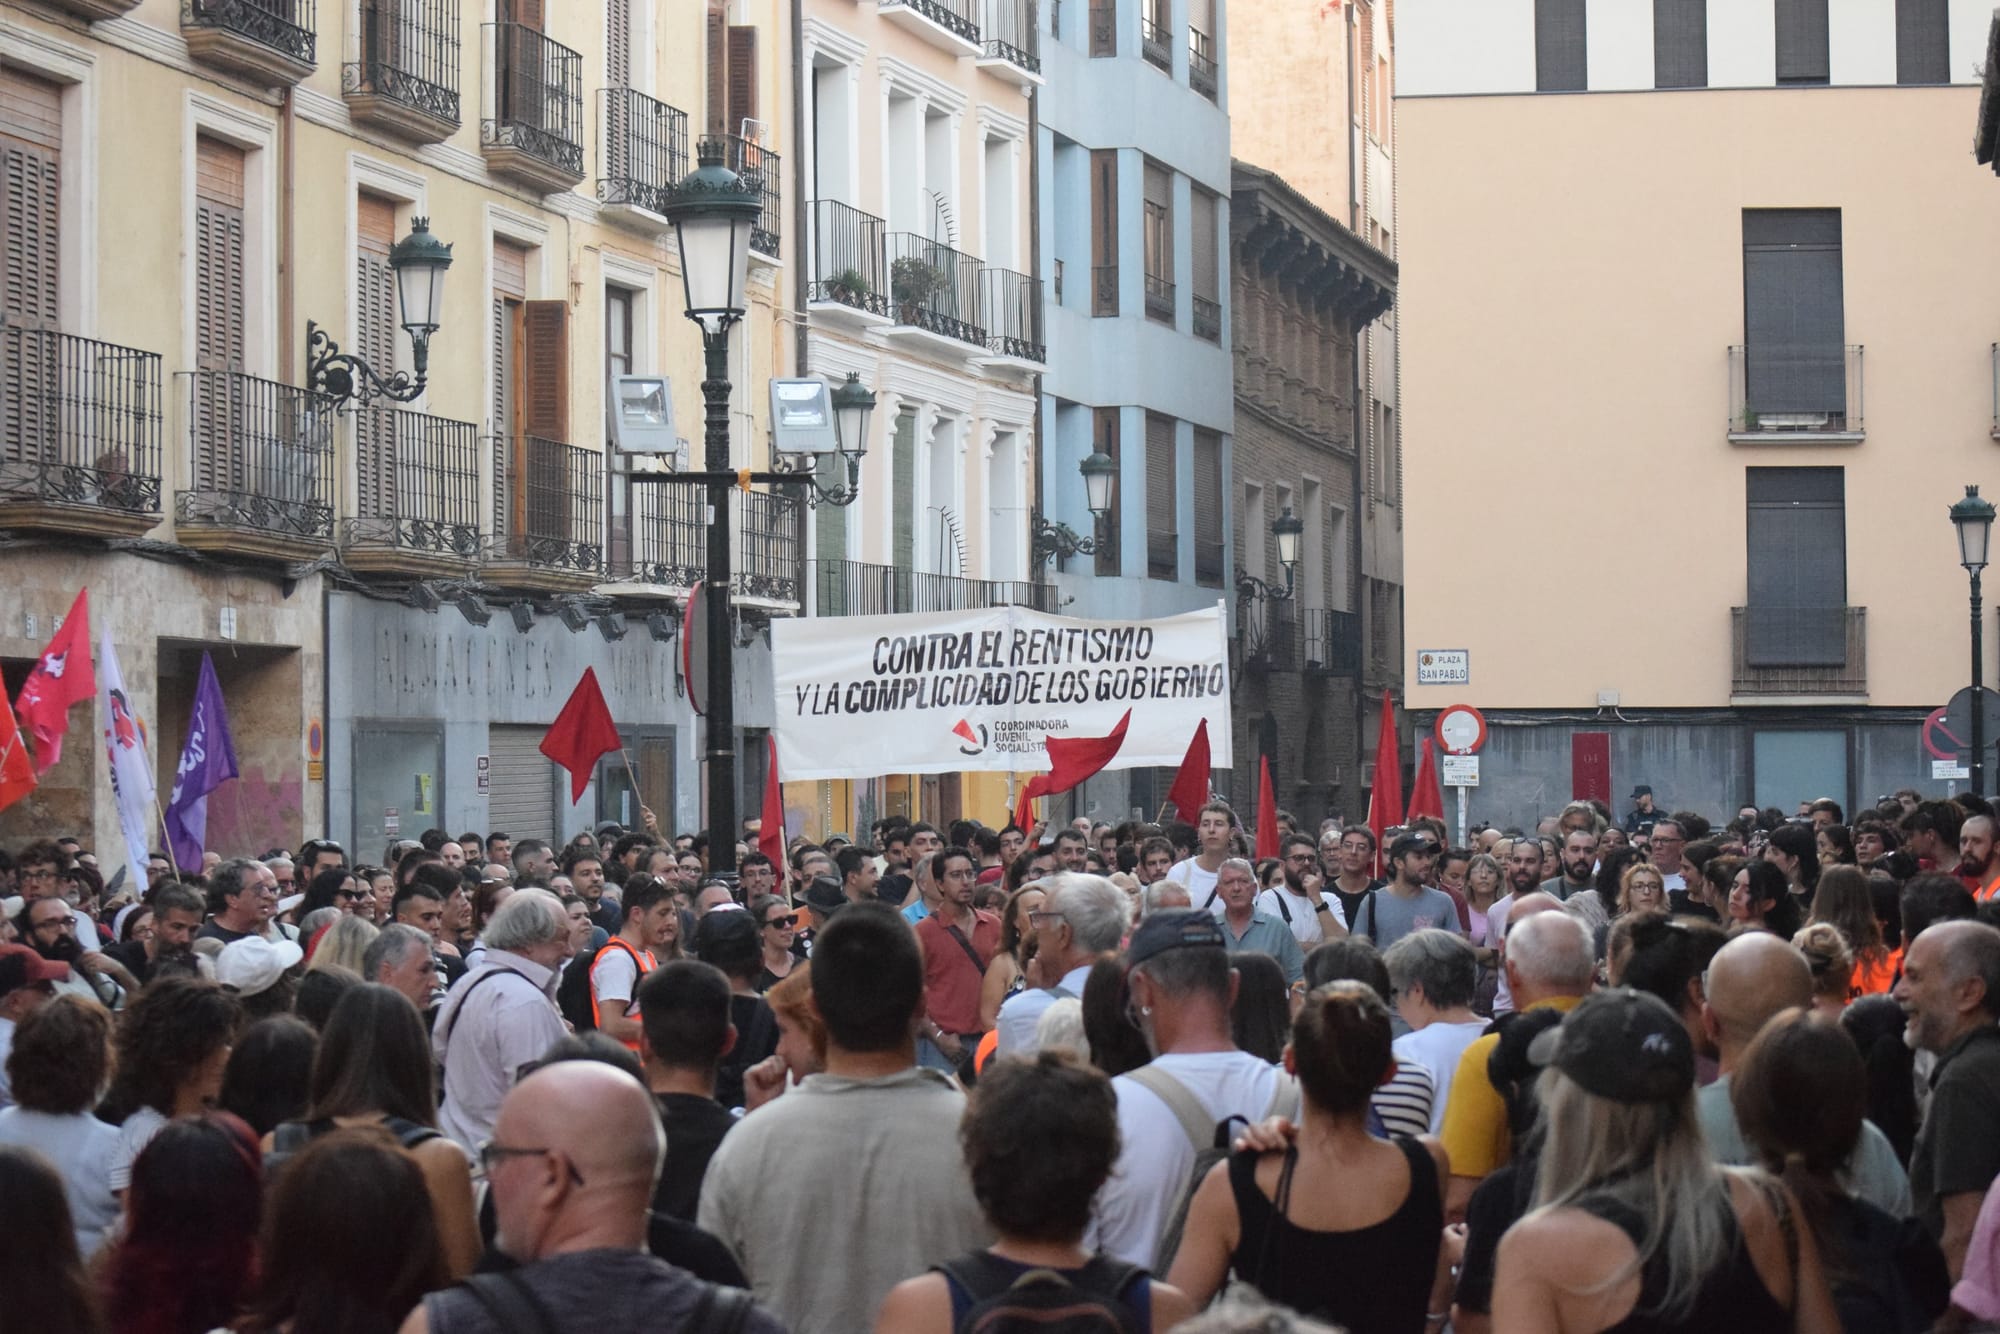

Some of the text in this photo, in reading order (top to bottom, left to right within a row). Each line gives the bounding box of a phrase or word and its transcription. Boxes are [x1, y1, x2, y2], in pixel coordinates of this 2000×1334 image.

[873, 627, 1154, 675] CONTRA EL RENTISMO
[1438, 655, 1462, 664] PLAZA
[1421, 668, 1467, 680] SAN PABLO
[796, 684, 811, 716] Y
[812, 682, 840, 716] LA
[844, 672, 1012, 714] COMPLICIDAD
[1014, 670, 1045, 705] DE
[1045, 669, 1090, 704] LOS
[994, 719, 1070, 732] COORDINADORA
[993, 731, 1032, 743] JUVENIL
